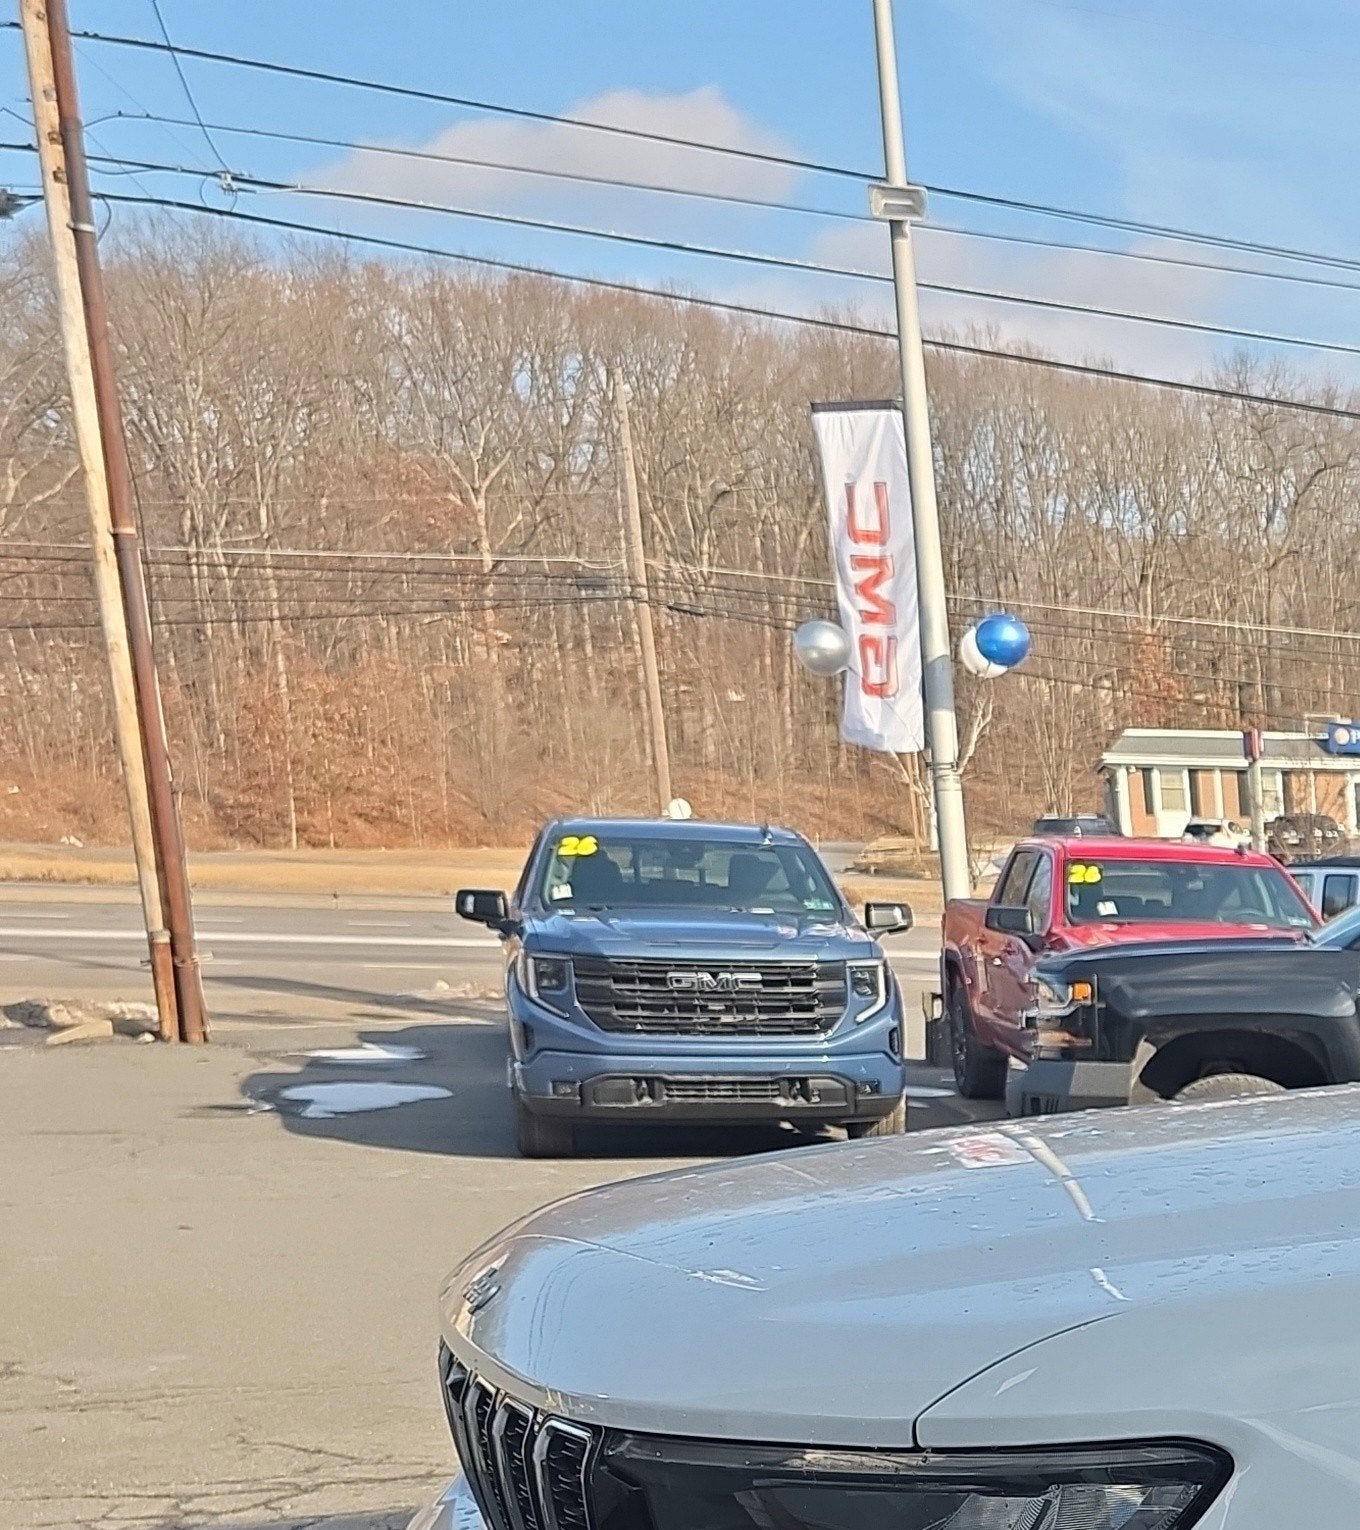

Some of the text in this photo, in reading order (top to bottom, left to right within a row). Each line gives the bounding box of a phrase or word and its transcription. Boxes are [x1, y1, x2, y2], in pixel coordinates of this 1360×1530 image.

[557, 835, 599, 856] 26
[1068, 864, 1102, 883] 26
[666, 971, 763, 991] GMC
